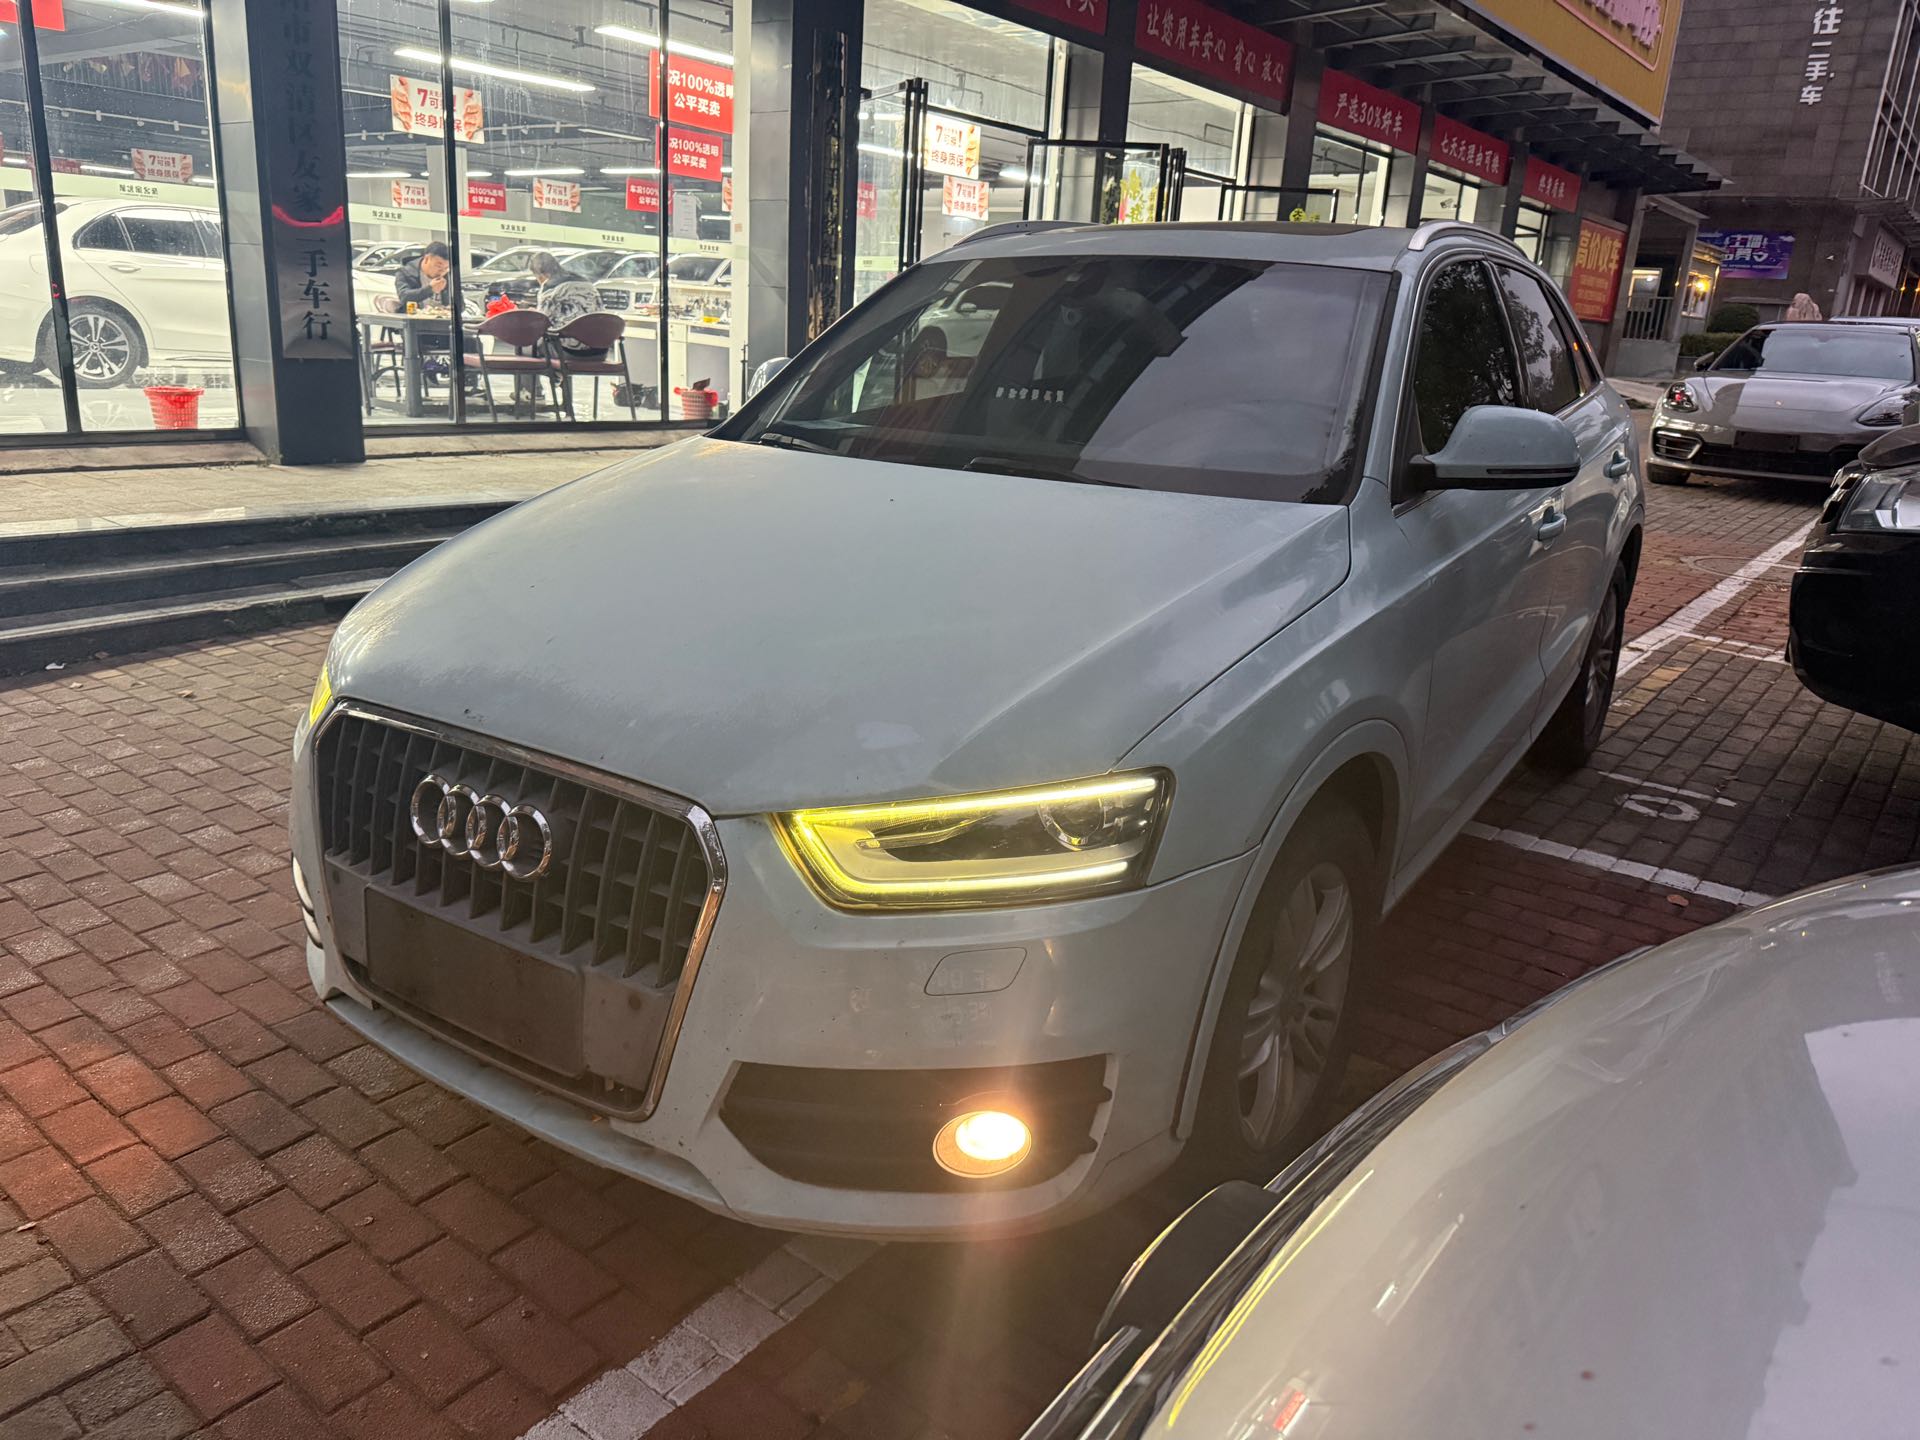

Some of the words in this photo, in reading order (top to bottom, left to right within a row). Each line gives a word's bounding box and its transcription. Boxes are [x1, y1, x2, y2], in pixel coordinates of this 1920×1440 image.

[1147, 4, 1227, 62] 让您用车安心
[1800, 0, 1843, 106] 往二手车
[656, 66, 734, 99] 况100%透明
[674, 92, 721, 117] 公平买卖
[1334, 93, 1403, 140] 严选30%好车
[415, 111, 463, 133] 终身保
[668, 137, 719, 157] 况100%透明
[672, 153, 707, 169] 公平买卖
[931, 150, 964, 167] 终身质保
[1575, 229, 1622, 275] 高价收车
